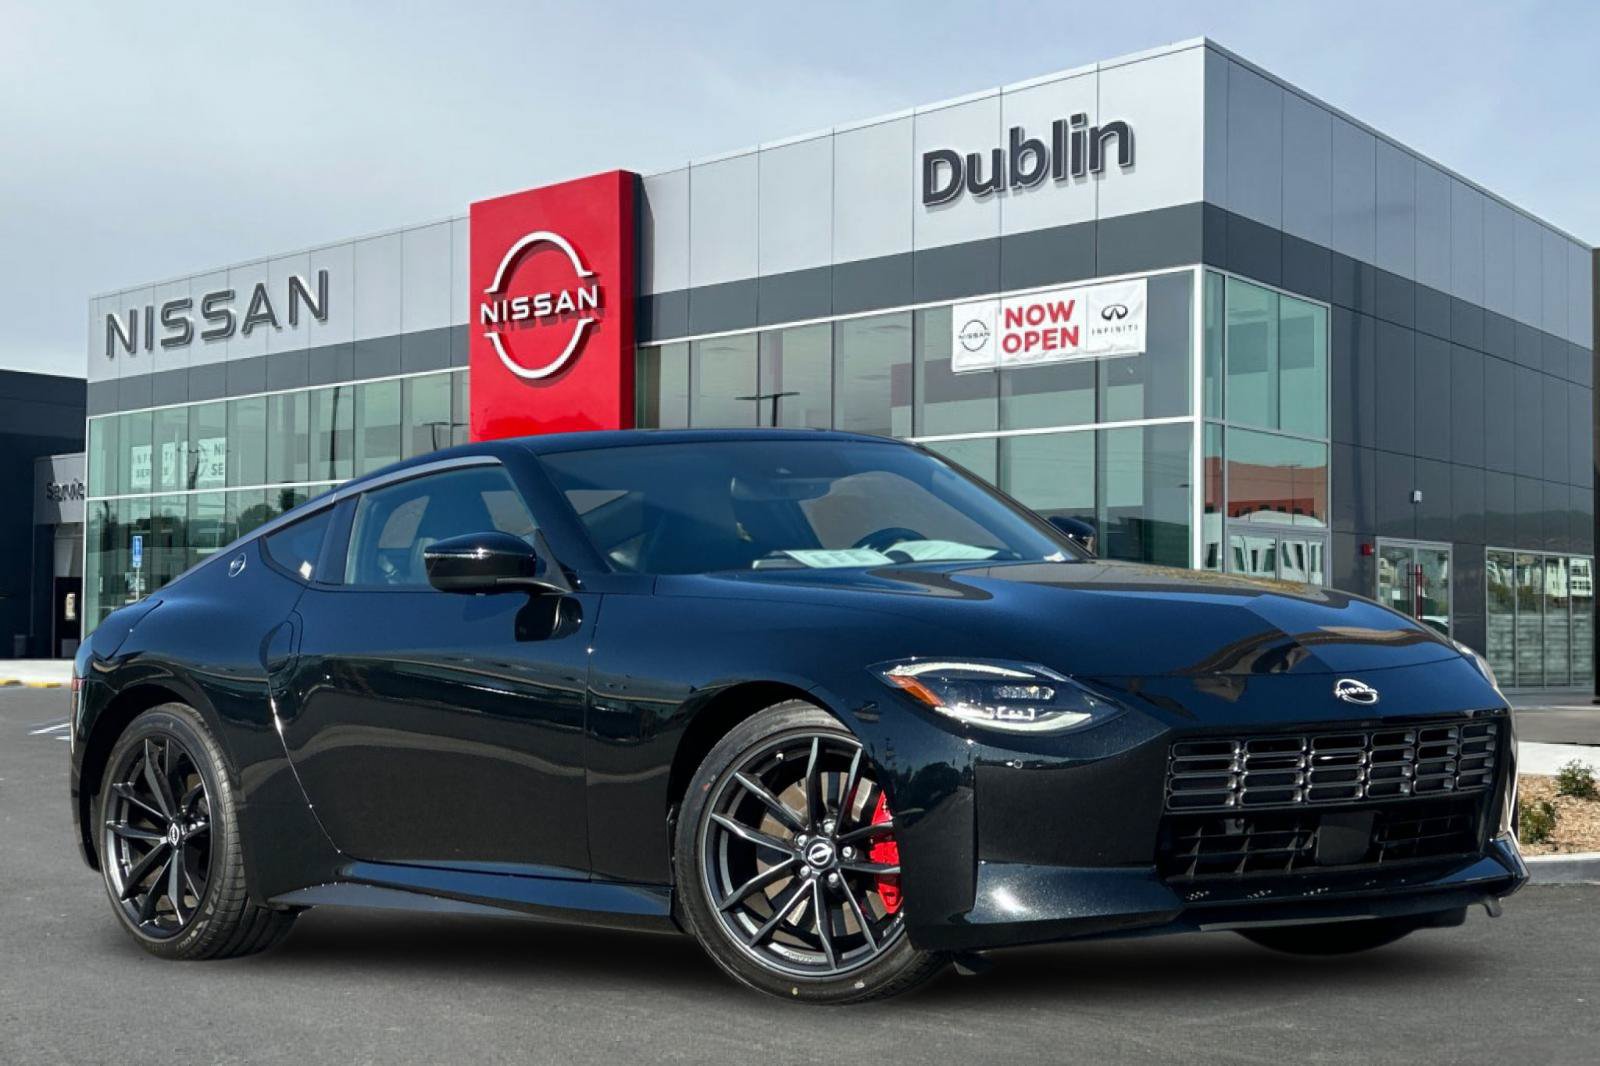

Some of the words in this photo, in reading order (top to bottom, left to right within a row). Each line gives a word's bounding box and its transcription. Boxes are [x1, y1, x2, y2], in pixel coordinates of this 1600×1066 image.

[923, 112, 1135, 207] Dublin
[105, 269, 329, 357] NISSAN
[480, 285, 598, 324] NISSAN
[1005, 300, 1075, 329] NOW
[1002, 326, 1079, 353] OPEN
